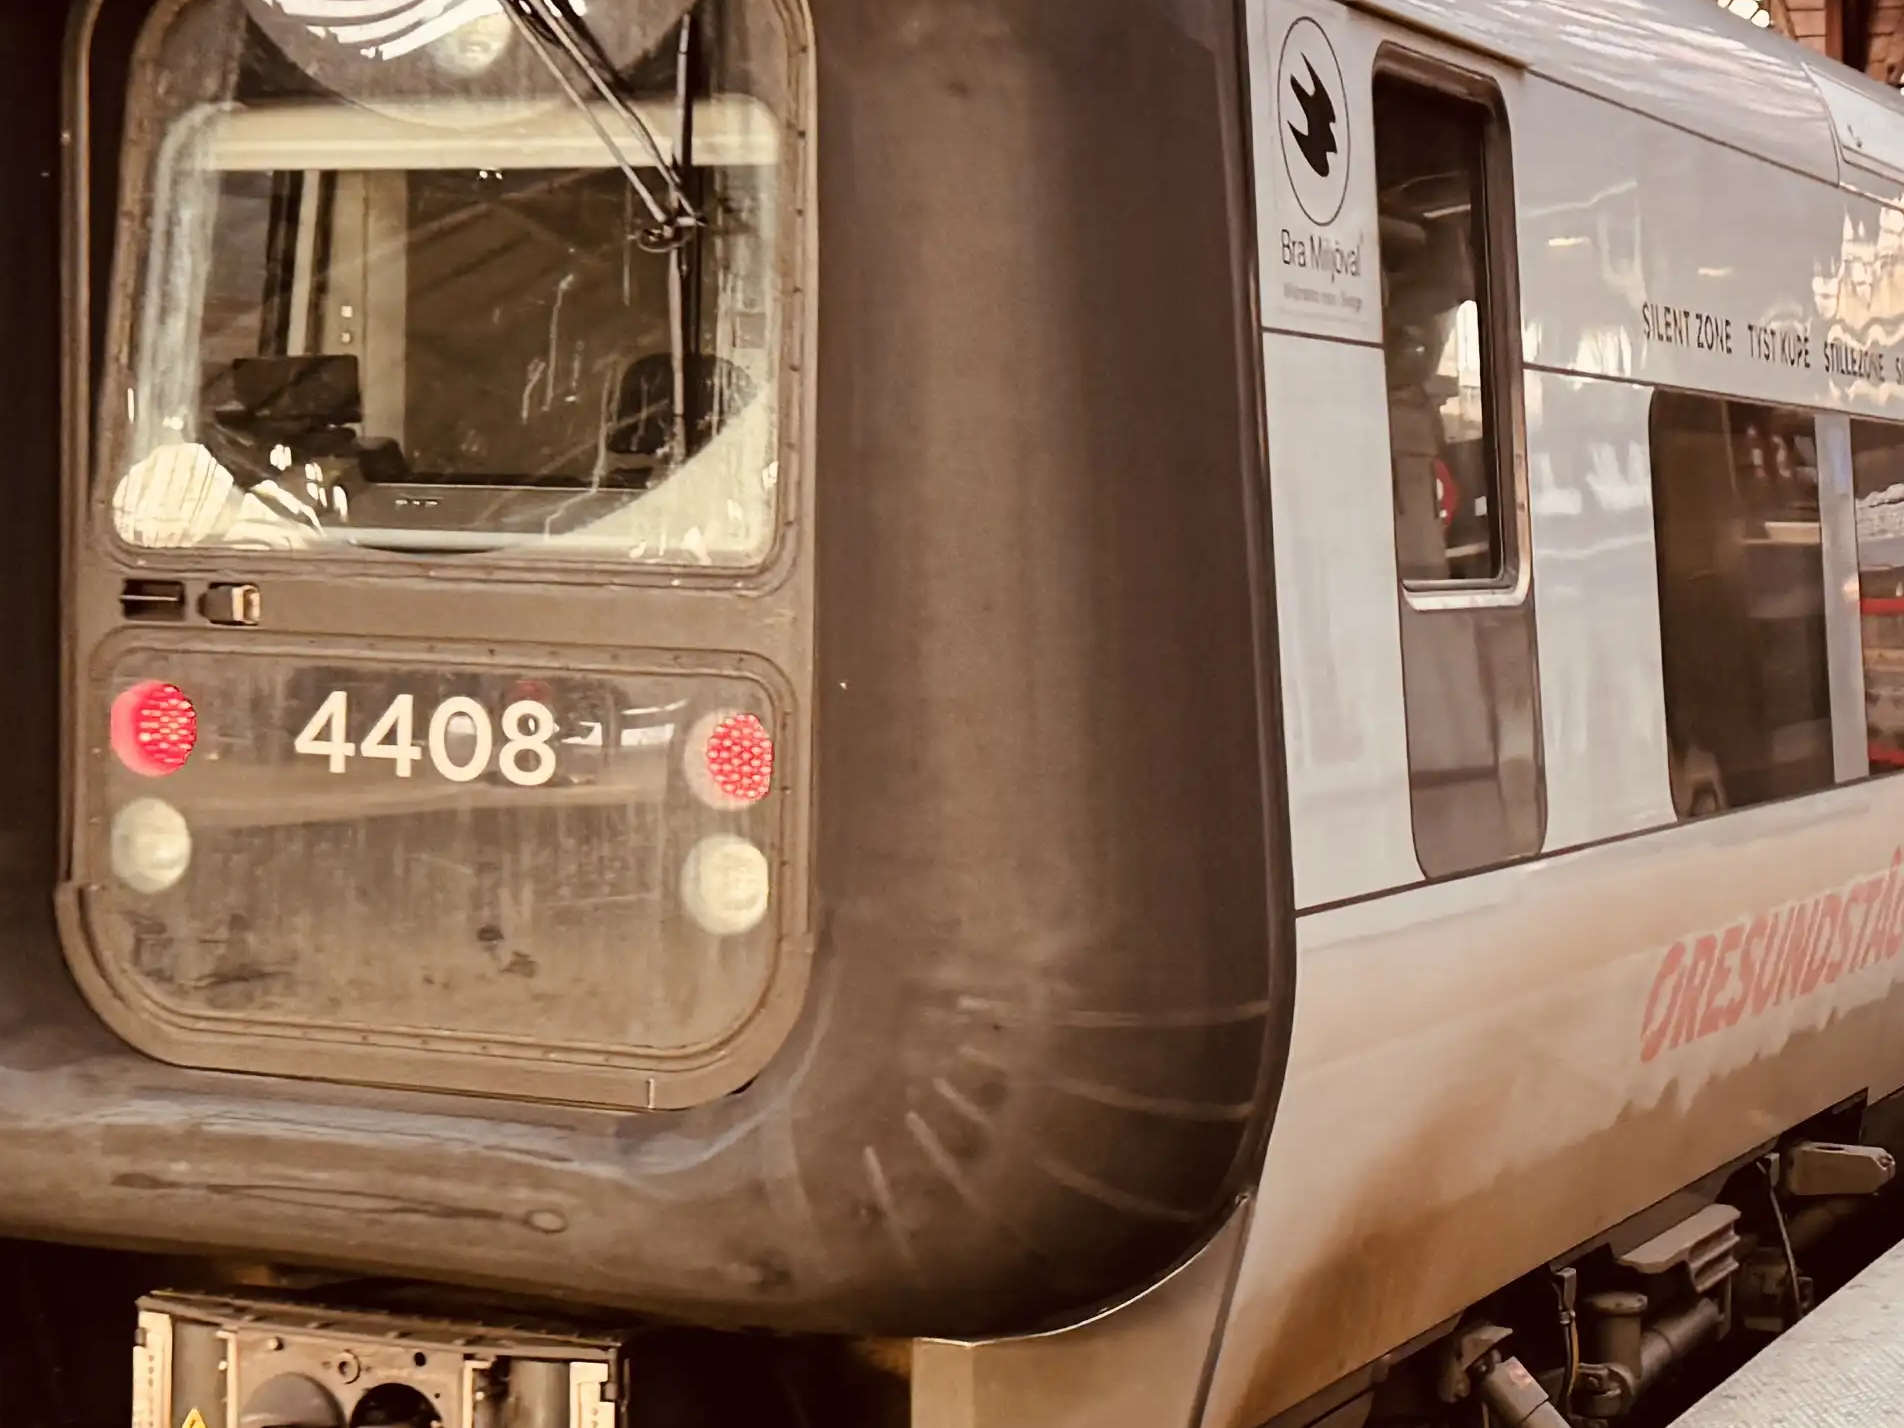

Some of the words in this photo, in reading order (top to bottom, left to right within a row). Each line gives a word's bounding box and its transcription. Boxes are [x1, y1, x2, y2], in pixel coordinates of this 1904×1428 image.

[1280, 228, 1307, 268] Bra
[1641, 302, 1691, 347] SILENT
[1695, 312, 1733, 355] ZONE
[1747, 324, 1777, 364] TYST
[293, 690, 557, 786] 4408
